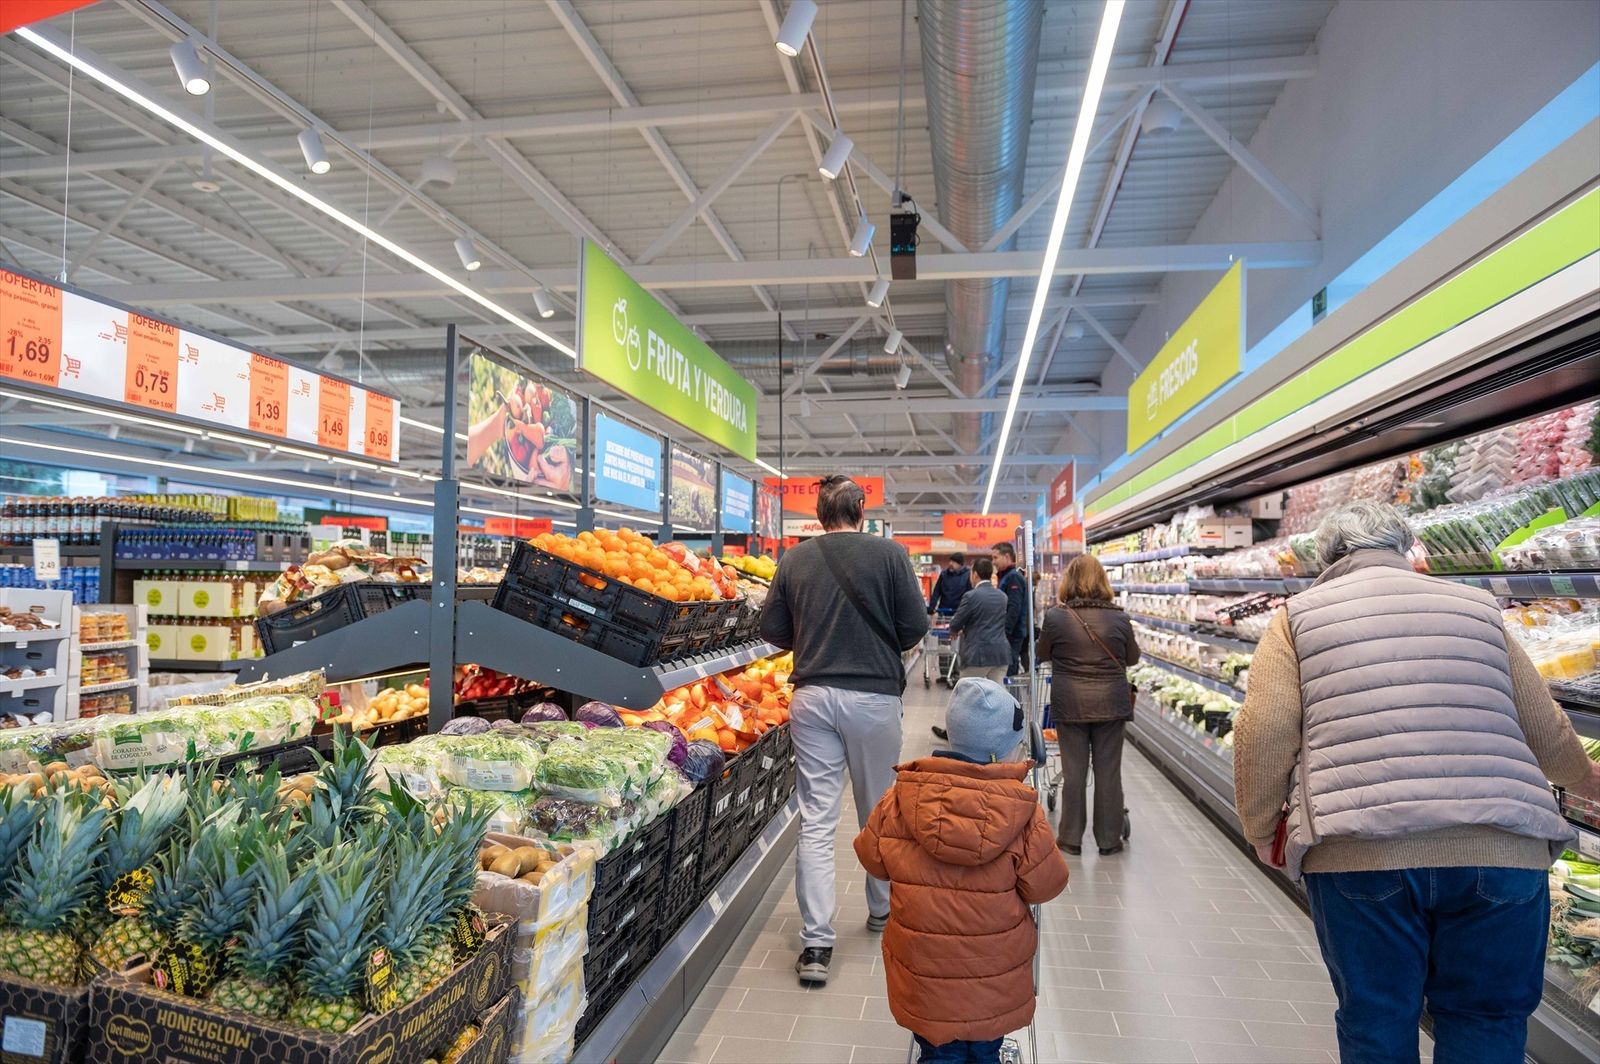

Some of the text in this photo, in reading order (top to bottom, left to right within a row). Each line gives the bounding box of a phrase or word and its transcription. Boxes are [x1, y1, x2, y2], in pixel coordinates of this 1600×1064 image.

[7, 335, 49, 364] 1,69
[135, 370, 168, 394] 0,75
[647, 328, 747, 433] FRUTA Y VERDURA
[1160, 338, 1198, 406] FRESCOS
[255, 401, 280, 421] 1,39
[323, 419, 343, 437] 1,49
[369, 431, 388, 448] 0,99
[793, 485, 806, 494] TE
[956, 518, 1008, 529] OFERTAS
[400, 977, 469, 1043] HONEYGLOW
[110, 1023, 122, 1034] Del
[122, 1026, 149, 1043] Monte
[156, 1009, 251, 1049] HONEYGLOW
[179, 1034, 228, 1054] PINEAPPLE
[182, 1045, 219, 1062] ANANAS
